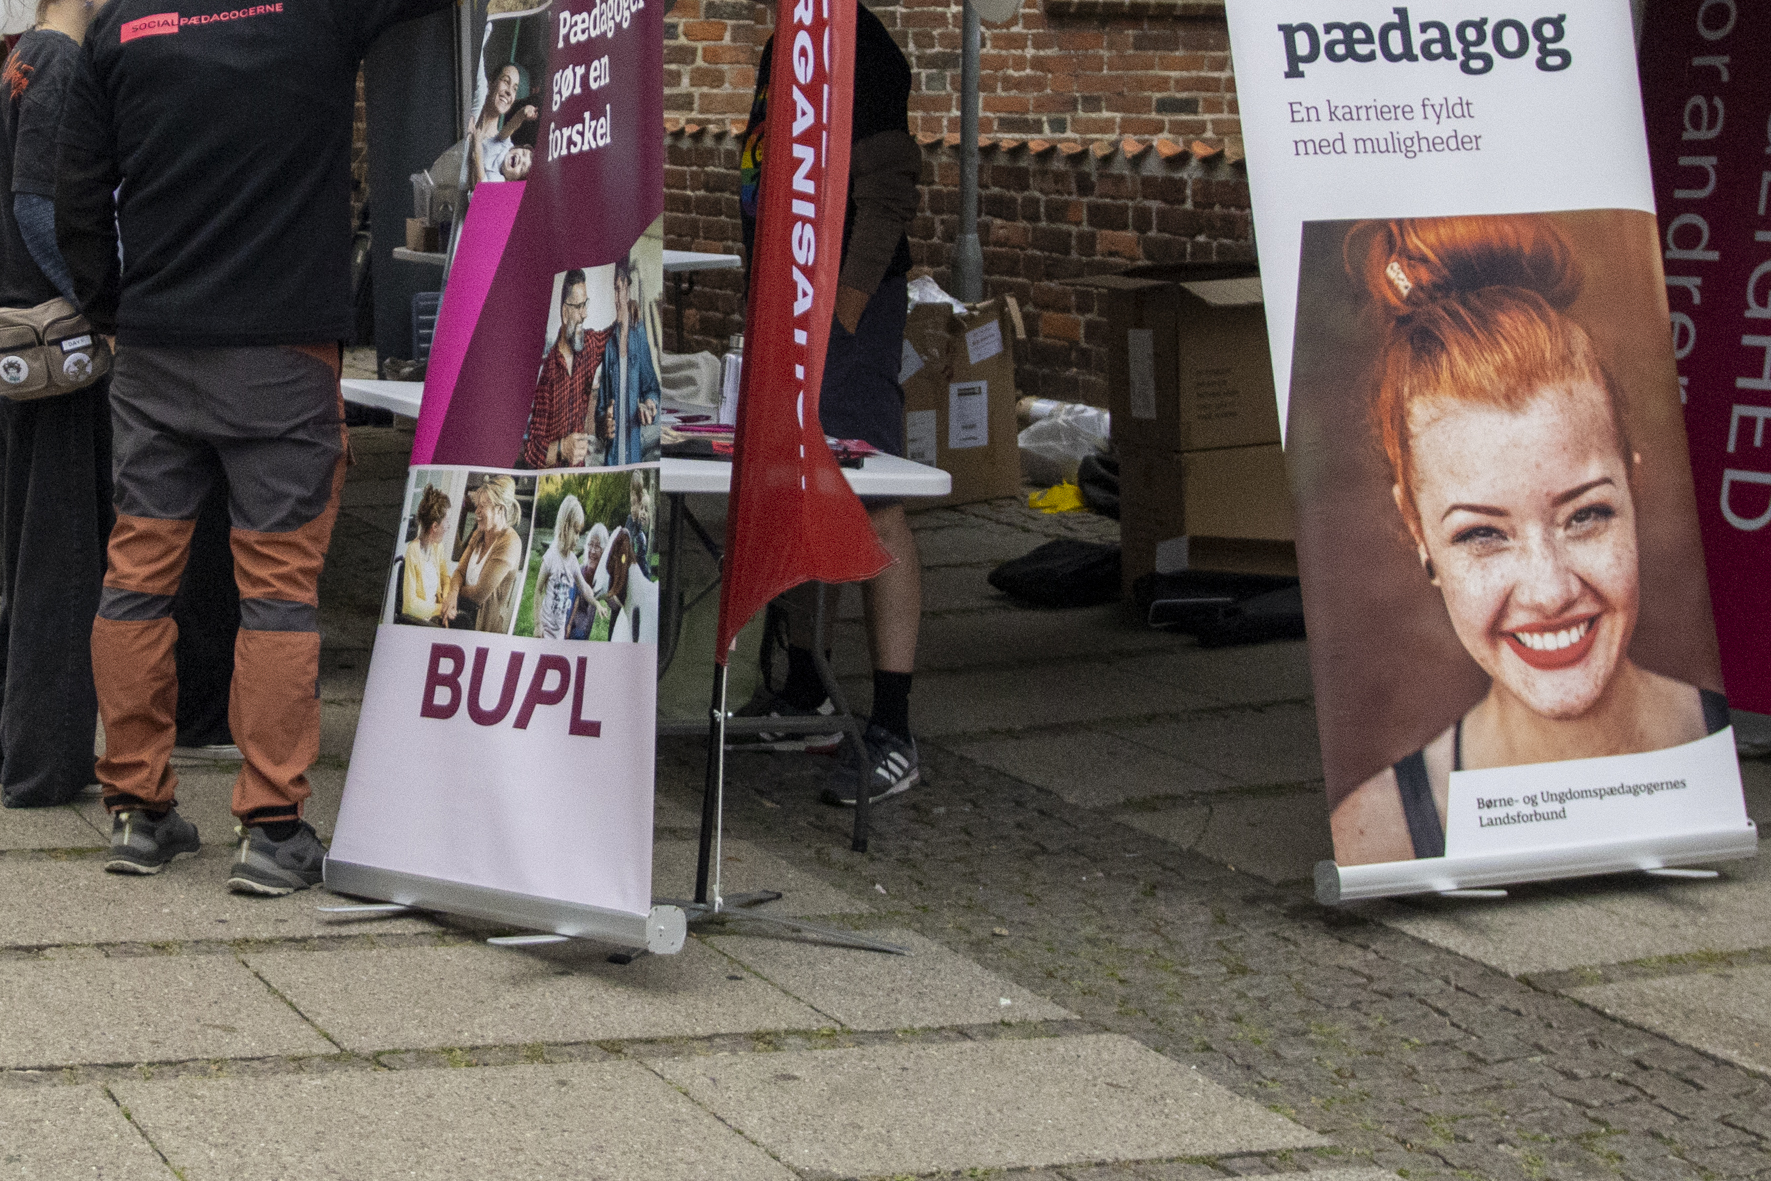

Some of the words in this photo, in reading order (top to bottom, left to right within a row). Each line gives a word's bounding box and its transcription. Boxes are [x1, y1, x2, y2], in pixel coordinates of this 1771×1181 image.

[1277, 6, 1573, 79] pædagog
[551, 62, 586, 112] gør
[589, 54, 610, 90] en
[1288, 100, 1321, 123] En
[1328, 97, 1415, 122] karriere
[1421, 96, 1475, 124] fyldt
[547, 103, 612, 163] forskel
[1293, 131, 1347, 157] med
[1353, 130, 1483, 159] muligheder
[420, 642, 603, 738] BUPL
[1476, 796, 1520, 810] Børne-
[1522, 793, 1539, 807] og
[1540, 778, 1688, 805] Ungdomspædagogernes
[1478, 806, 1568, 828] Landsforbund
